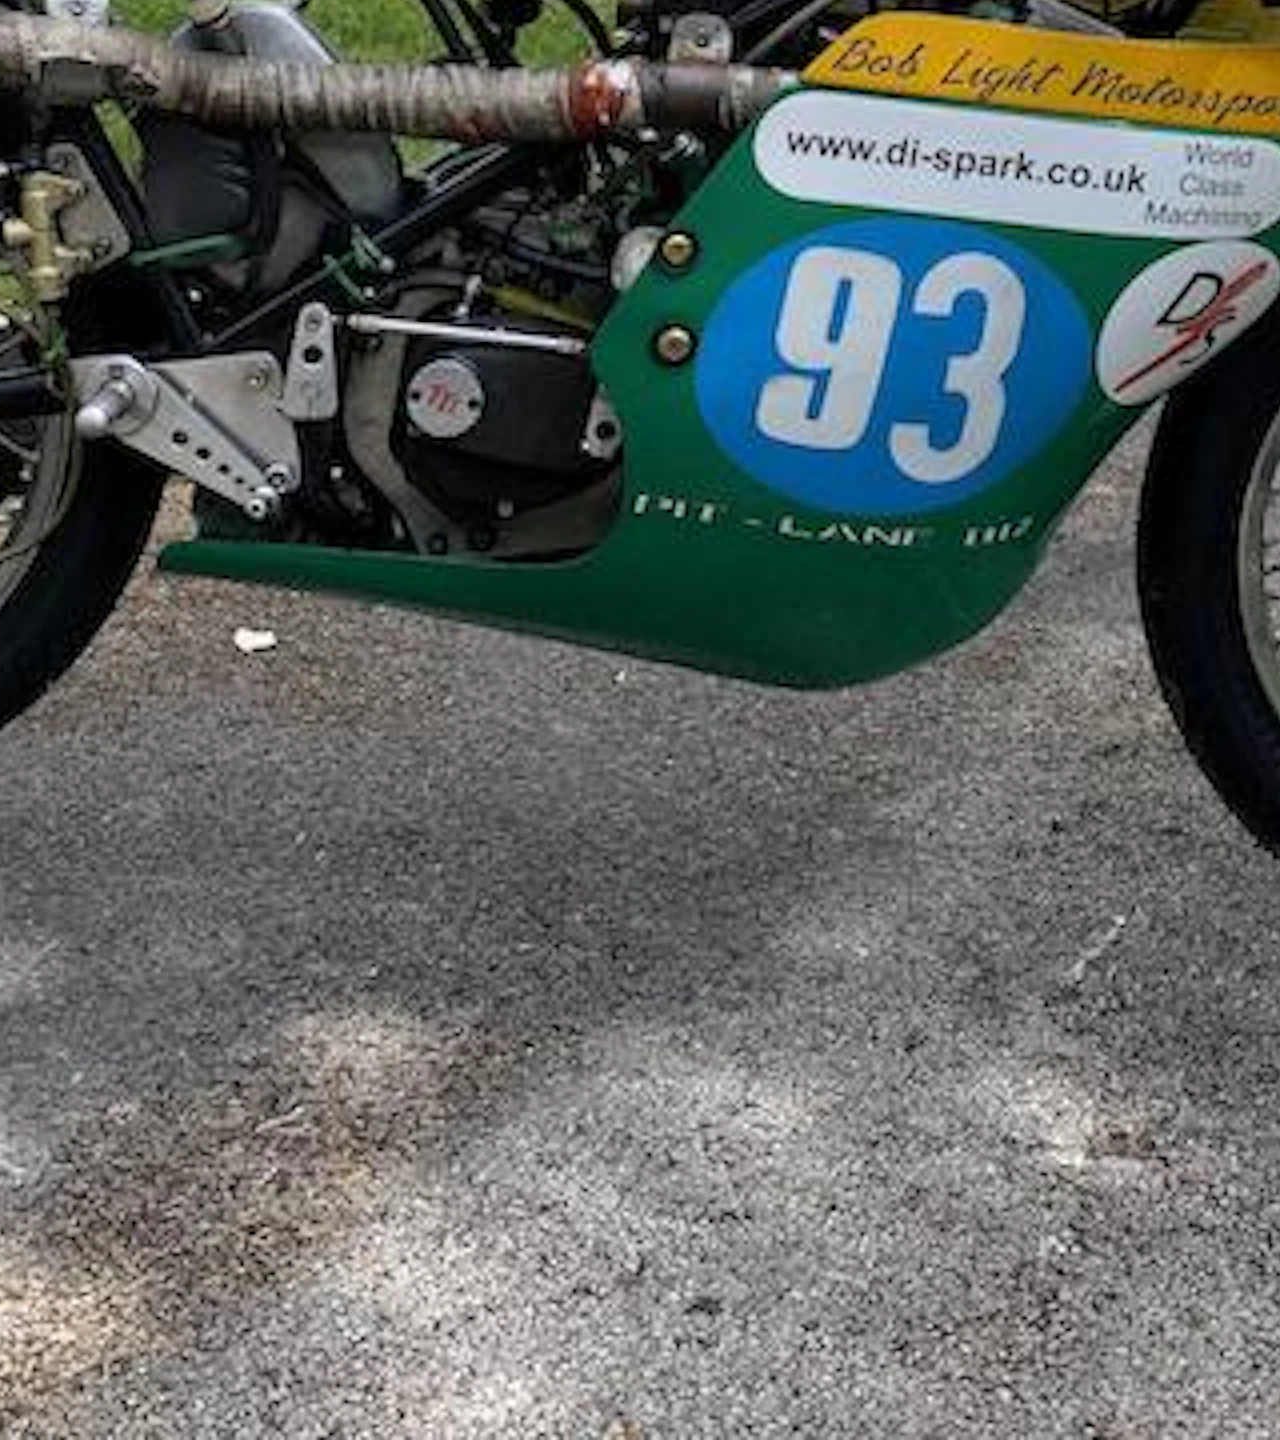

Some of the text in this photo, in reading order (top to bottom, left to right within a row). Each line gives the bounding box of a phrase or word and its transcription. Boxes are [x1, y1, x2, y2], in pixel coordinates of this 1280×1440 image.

[832, 38, 923, 76] Bob
[940, 48, 1065, 101] Light
[786, 127, 1147, 194] www.di-spark.co.uk
[1184, 141, 1255, 168] World
[1179, 173, 1245, 198] Class
[1143, 200, 1263, 228] Machining
[755, 245, 1026, 484] 93
